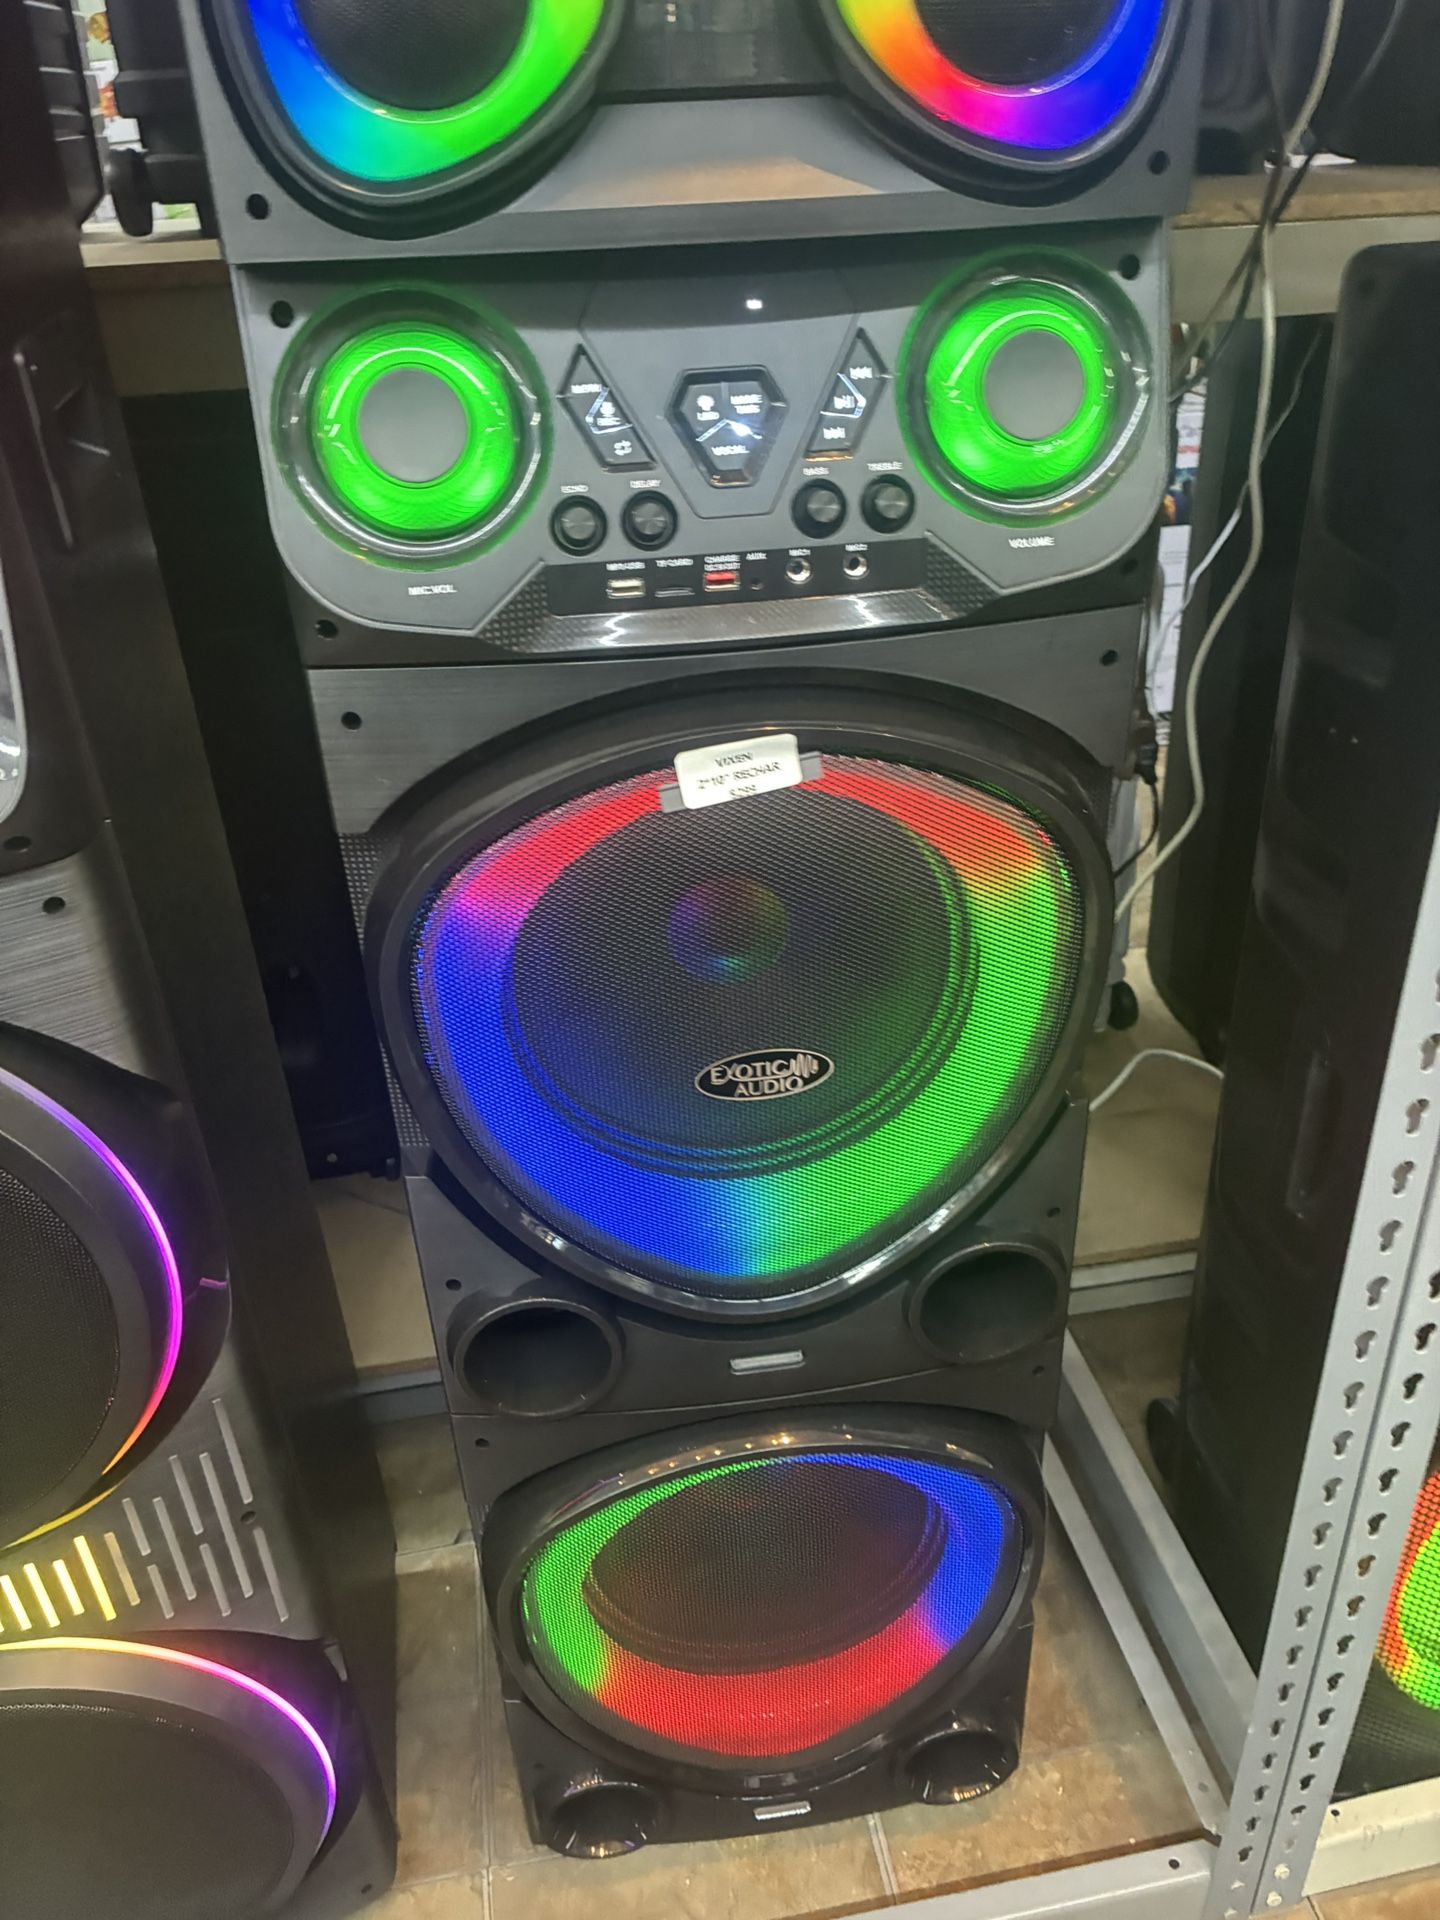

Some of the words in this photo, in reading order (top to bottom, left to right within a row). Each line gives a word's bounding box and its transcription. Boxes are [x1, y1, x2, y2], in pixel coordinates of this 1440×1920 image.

[697, 412, 720, 421] LED
[803, 466, 830, 476] BASS
[867, 460, 903, 472] TREBLE
[1008, 536, 1056, 549] VOLUME
[746, 551, 768, 561] AUX
[709, 1059, 791, 1086] EXOTIC
[734, 1076, 804, 1097] AUDIO
